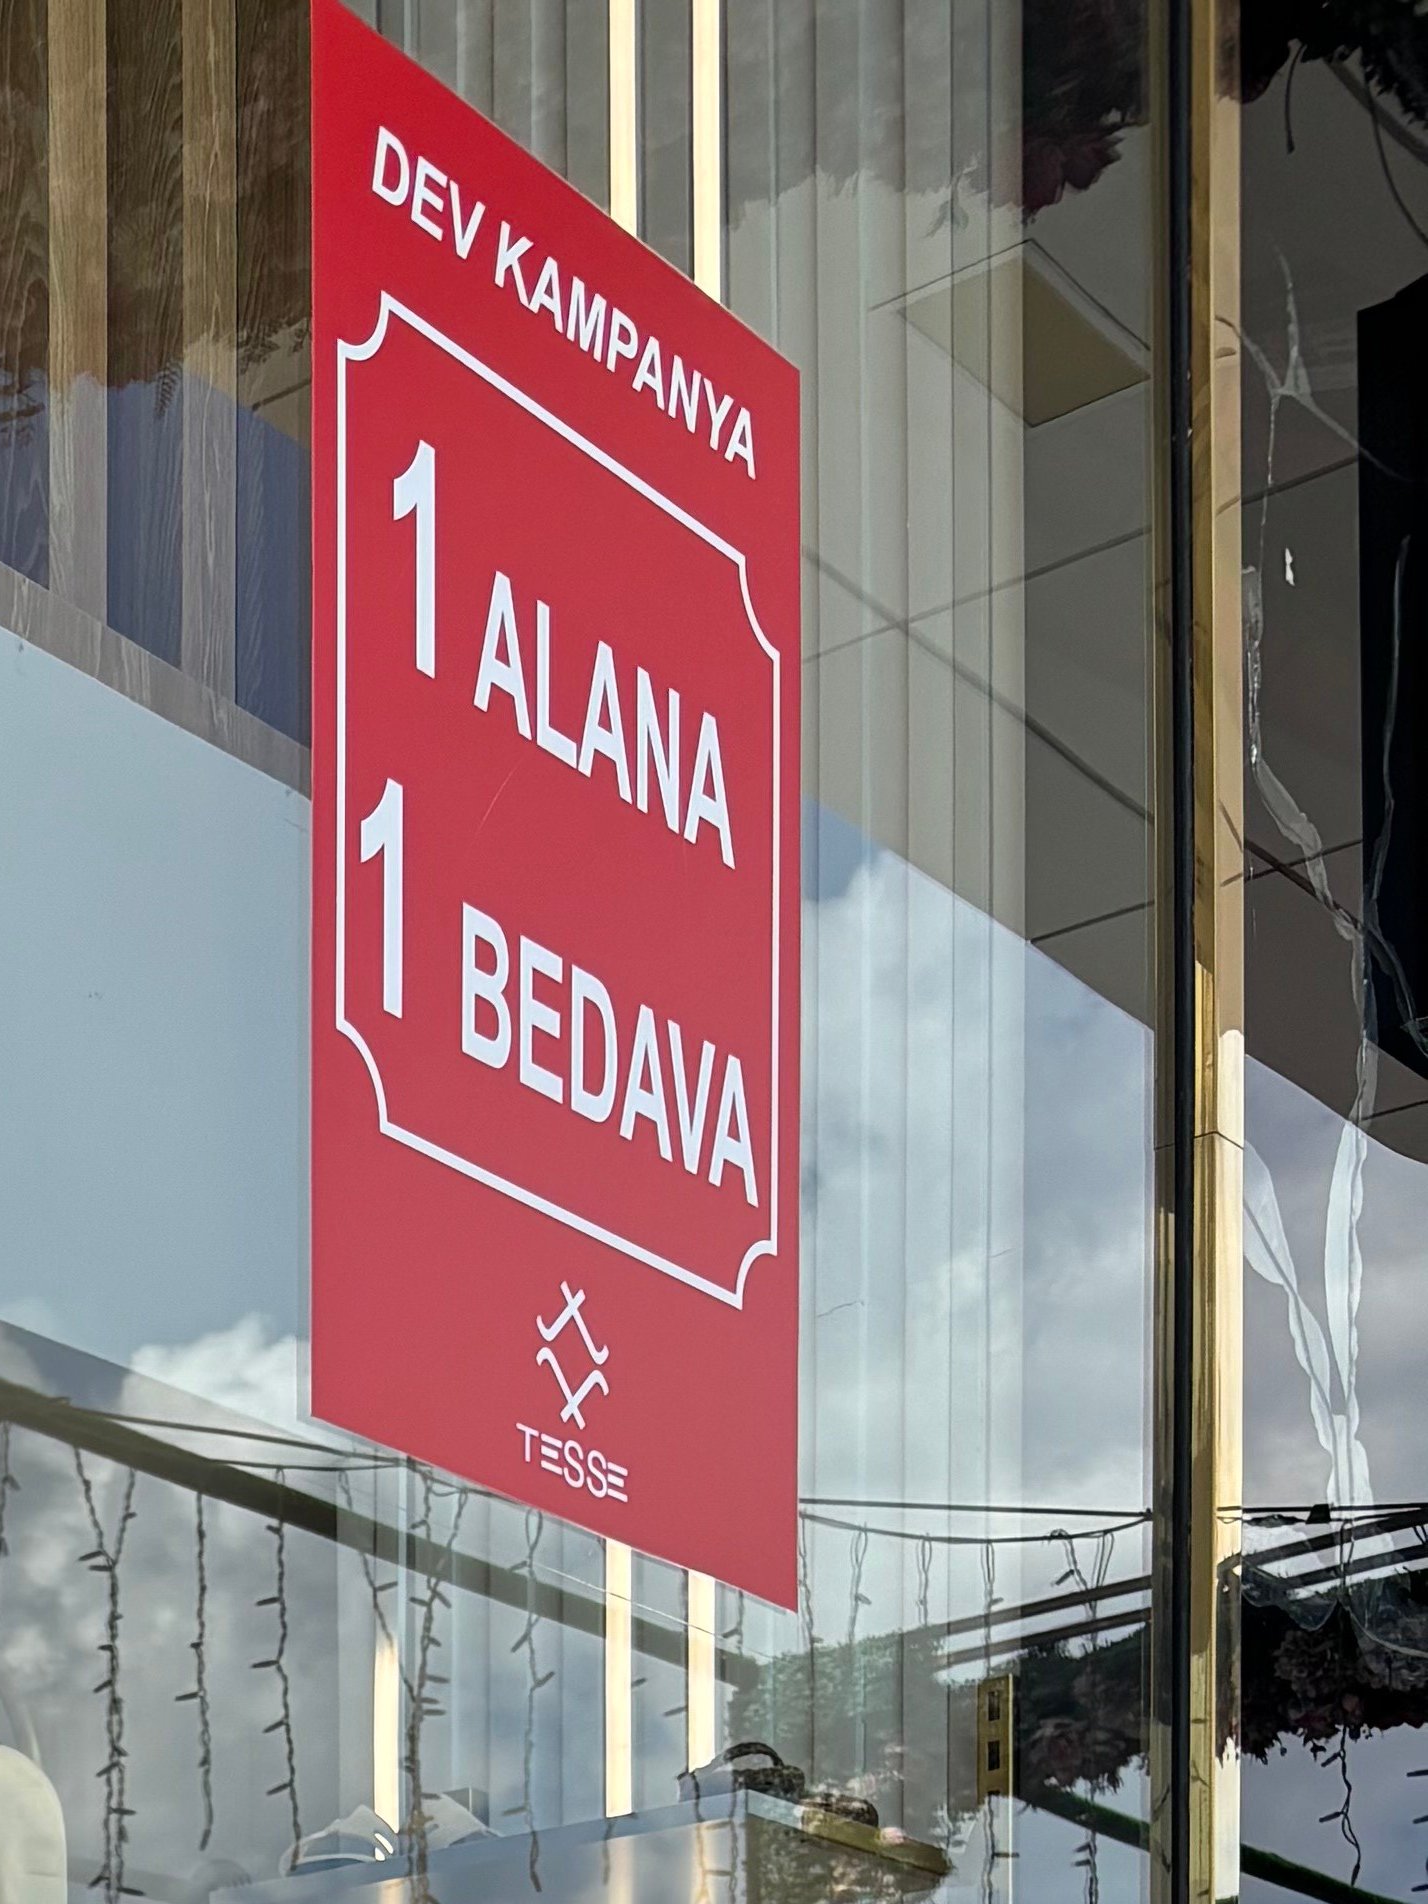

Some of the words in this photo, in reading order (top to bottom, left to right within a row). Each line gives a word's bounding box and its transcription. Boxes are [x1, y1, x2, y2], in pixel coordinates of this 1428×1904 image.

[371, 125, 486, 261] DEV
[494, 220, 757, 481] KAMPANYA
[393, 439, 436, 679] 1
[473, 570, 736, 871] ALANA
[360, 777, 404, 1019] 1
[461, 901, 760, 1209] BEDAVA
[515, 1422, 630, 1504] TESSE
